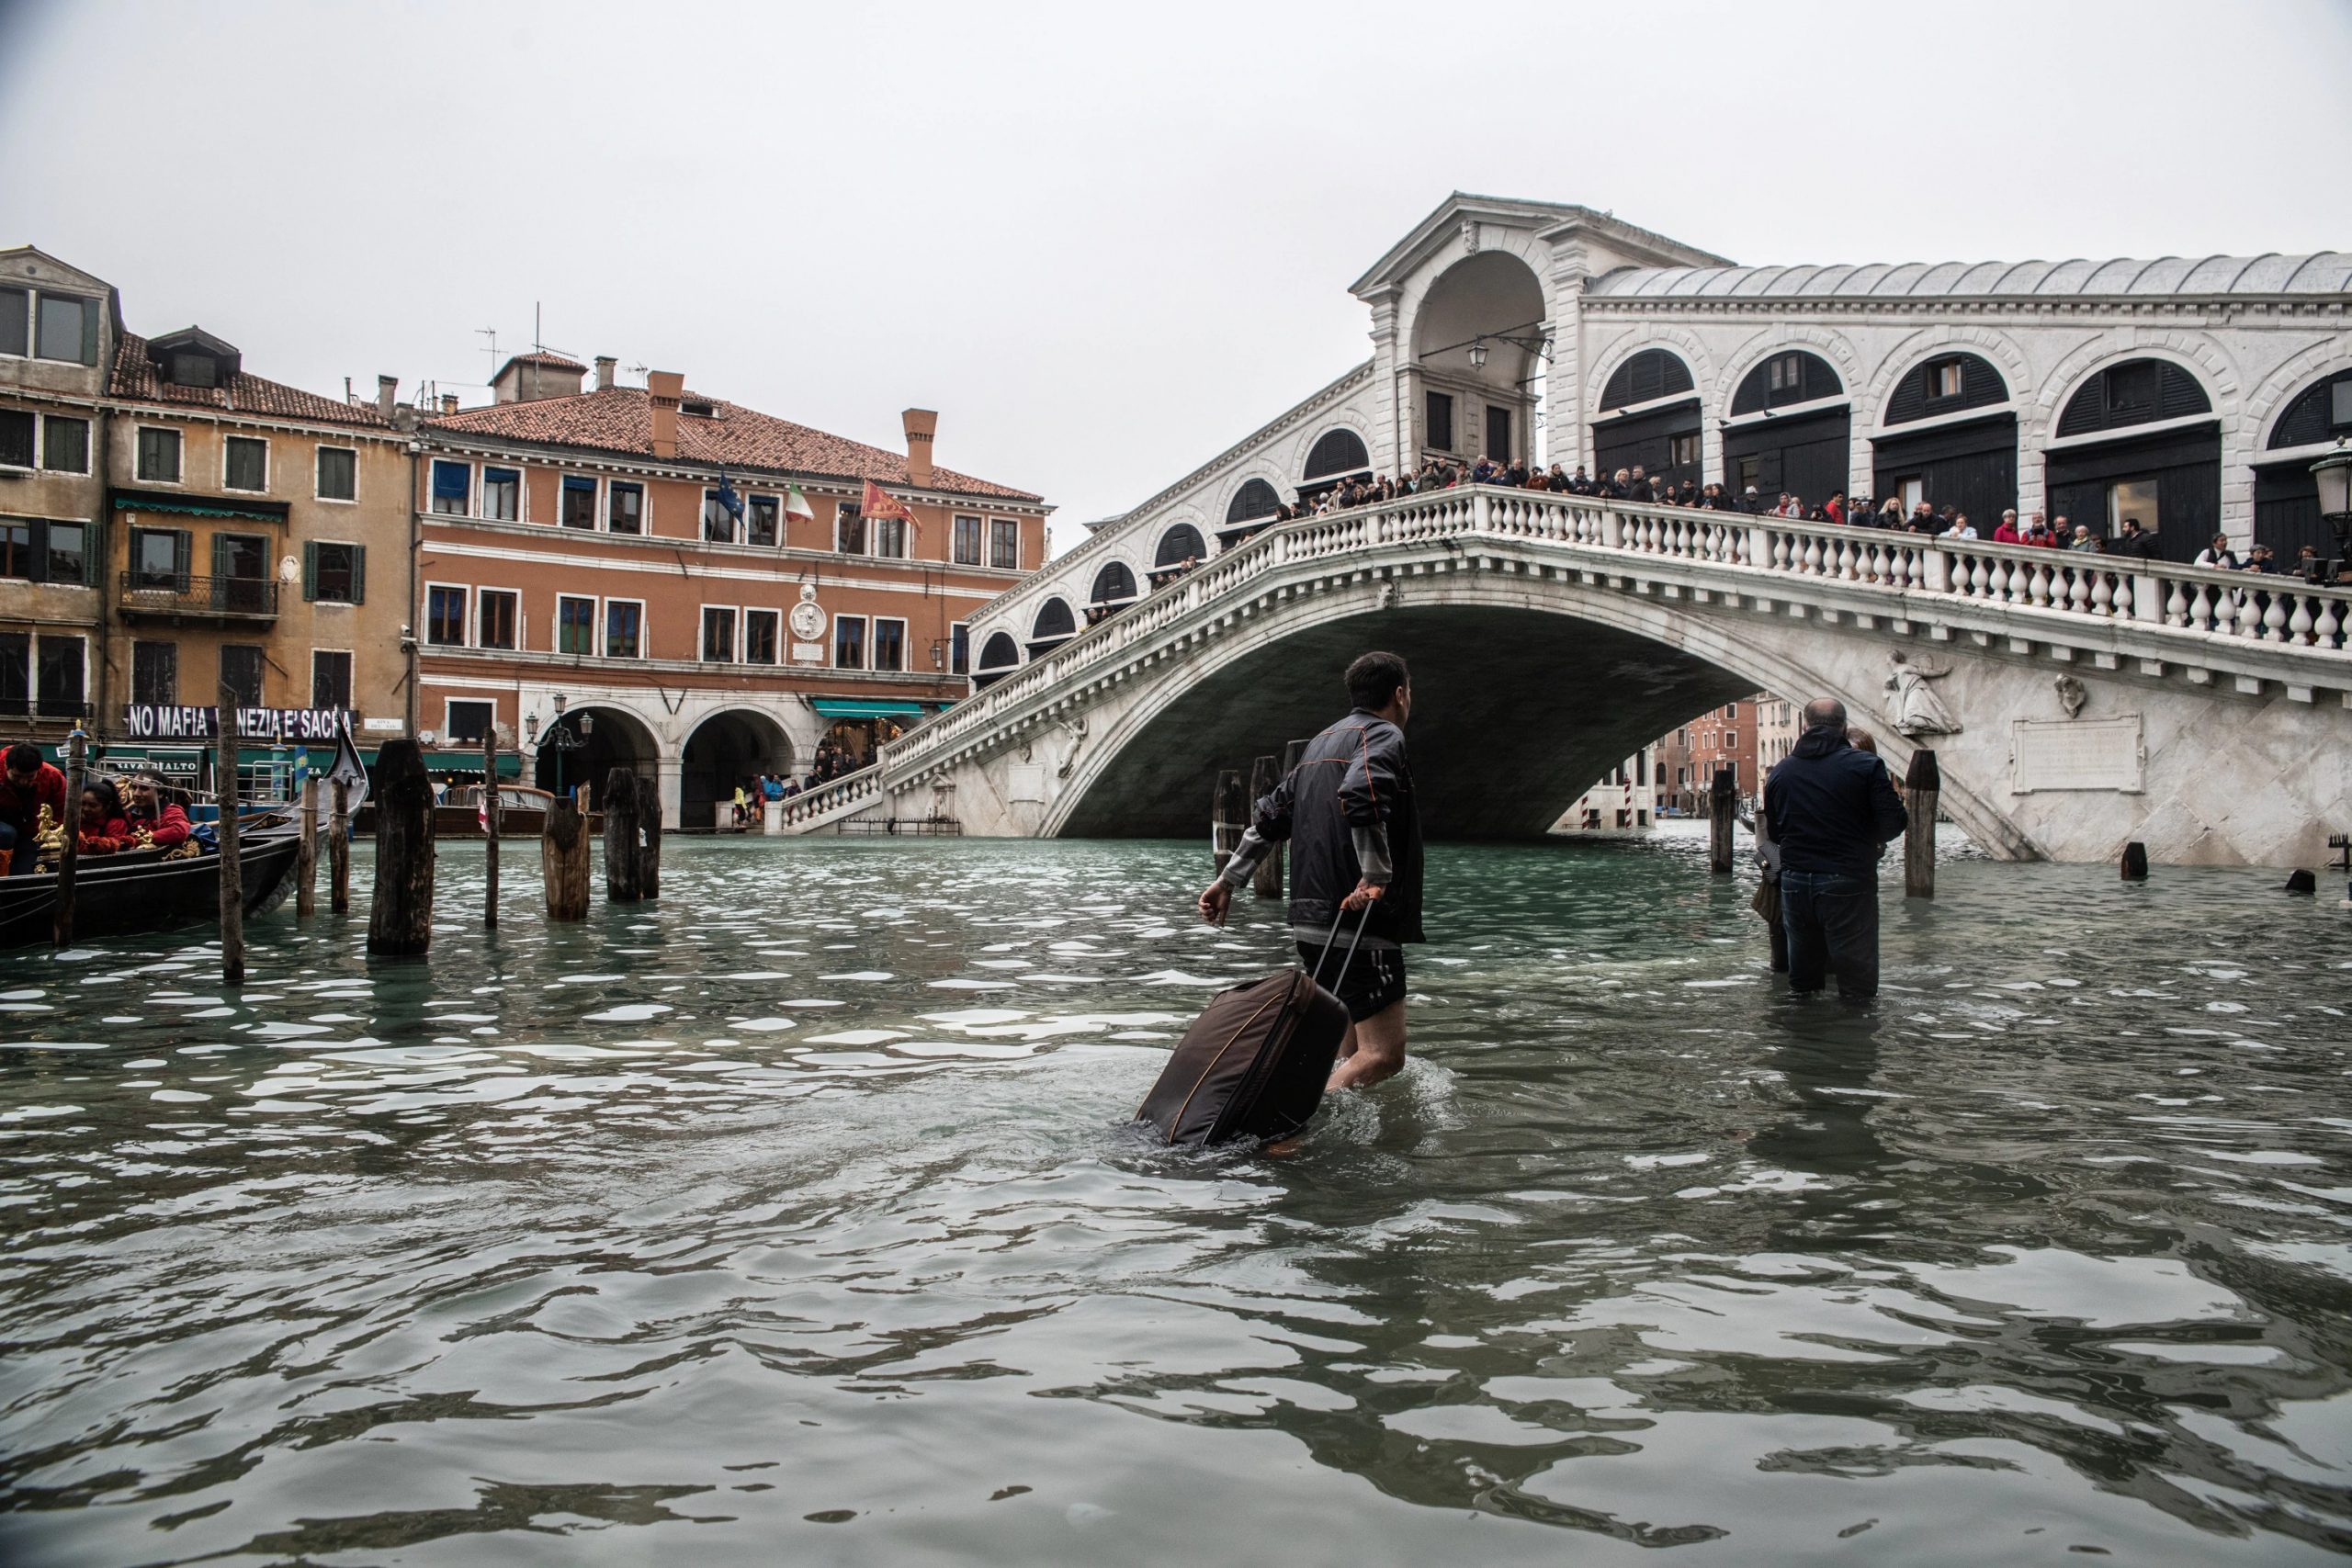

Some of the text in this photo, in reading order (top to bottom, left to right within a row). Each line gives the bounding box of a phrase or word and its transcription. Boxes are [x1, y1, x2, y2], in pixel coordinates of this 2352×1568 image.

[130, 705, 153, 736] NO
[158, 706, 208, 736] MAFIA
[214, 707, 280, 737] NEZIA
